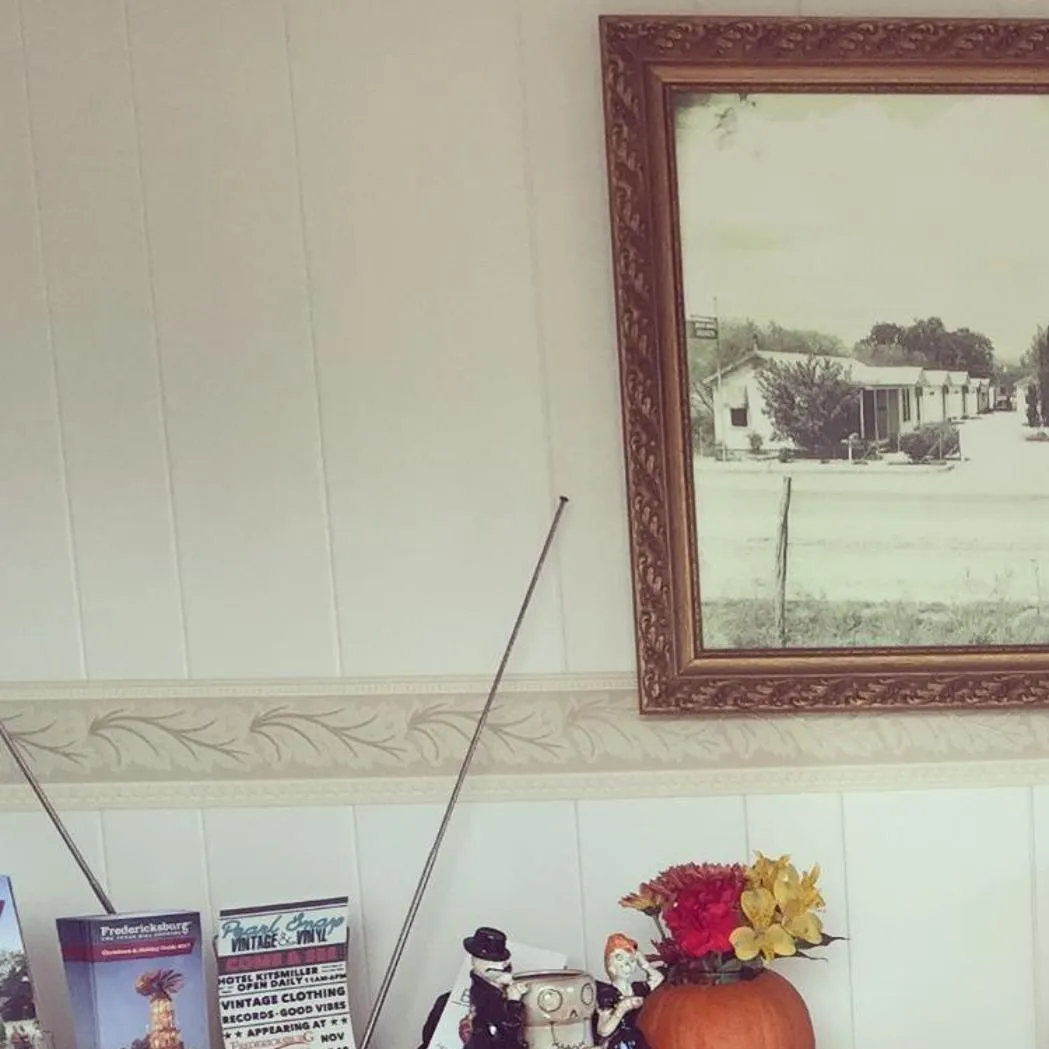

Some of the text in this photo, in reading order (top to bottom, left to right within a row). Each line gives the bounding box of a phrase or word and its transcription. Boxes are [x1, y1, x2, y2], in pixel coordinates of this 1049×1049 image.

[100, 920, 192, 937] Fredericksburg
[221, 913, 345, 939] Pearl Snap
[231, 933, 279, 952] VINTAGE
[296, 928, 328, 945] VINYL
[218, 975, 252, 985] HOTEL
[255, 967, 319, 981] KITSMILLER
[237, 982, 268, 992] OPEN
[271, 977, 303, 988] DAILY
[221, 986, 346, 1010] VINTAGE CLOTHING
[222, 1010, 273, 1024] RECORDS
[280, 1005, 313, 1017] GOOD
[316, 1001, 346, 1012] VIBES
[247, 1019, 326, 1037] APPEARING AT
[321, 1032, 345, 1043] NOV
